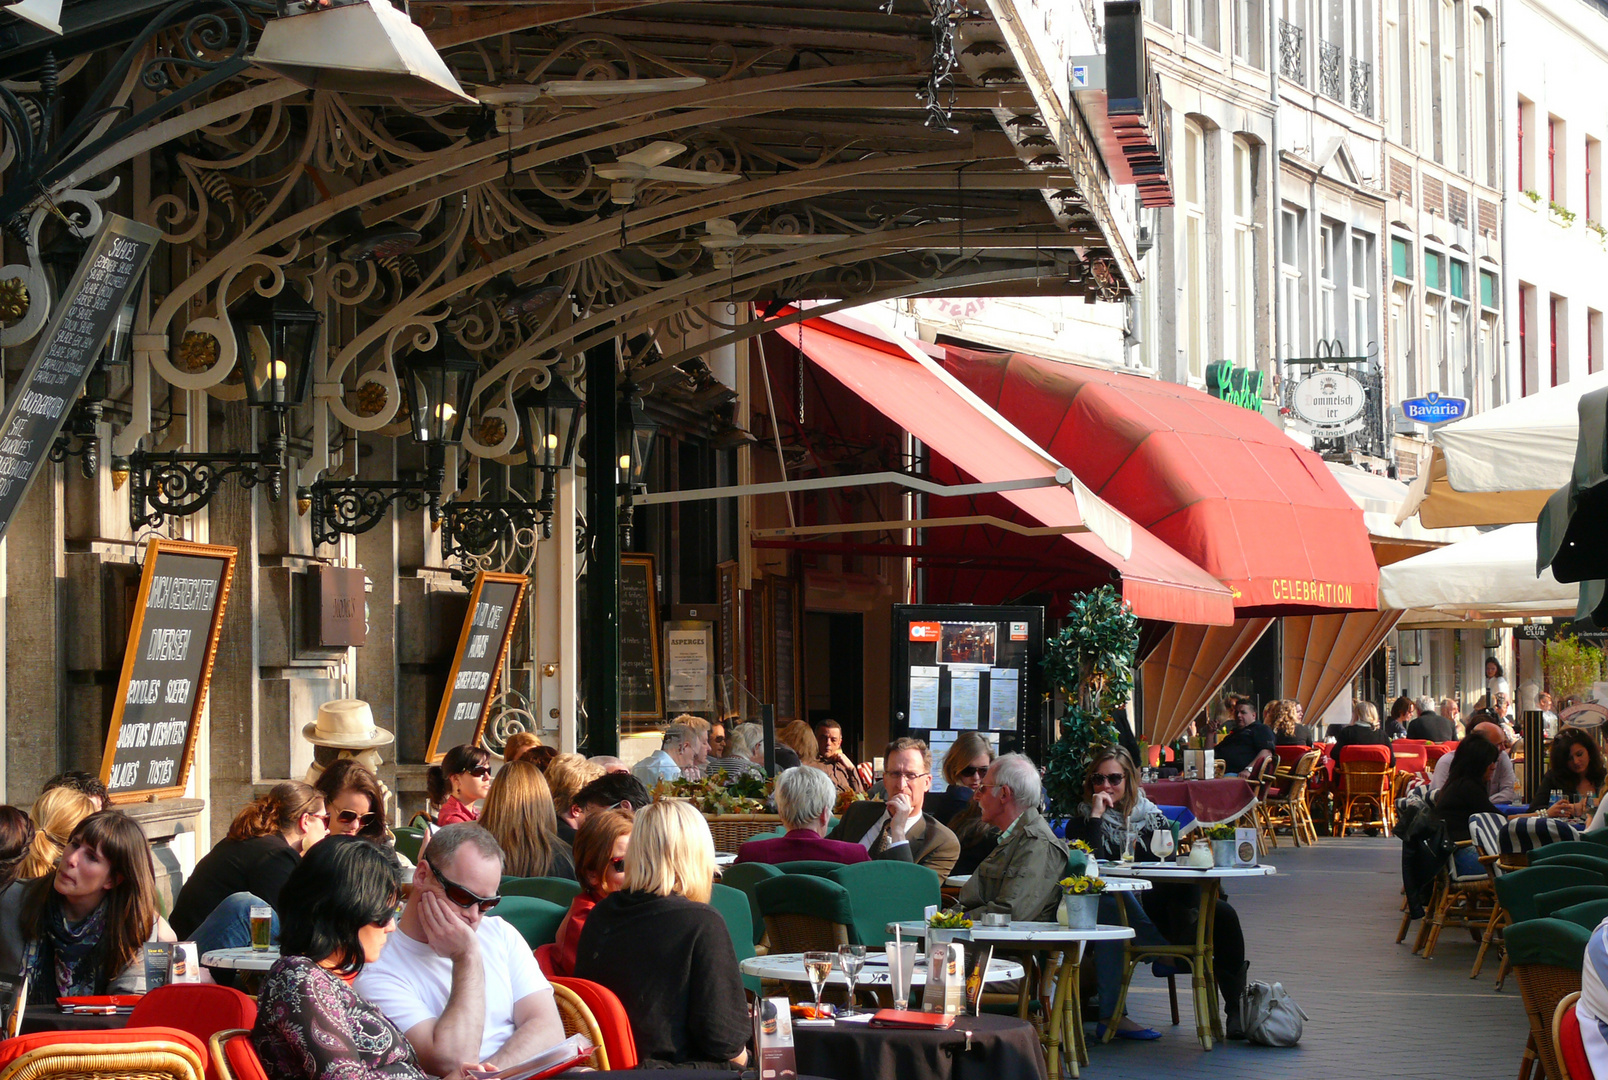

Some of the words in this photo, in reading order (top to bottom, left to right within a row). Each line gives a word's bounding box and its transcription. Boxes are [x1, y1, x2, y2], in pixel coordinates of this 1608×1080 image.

[108, 237, 139, 261] SALADES
[1409, 403, 1459, 417] Bavaria
[169, 577, 218, 610] GERECHTEN
[1272, 579, 1352, 604] CELEBRATION
